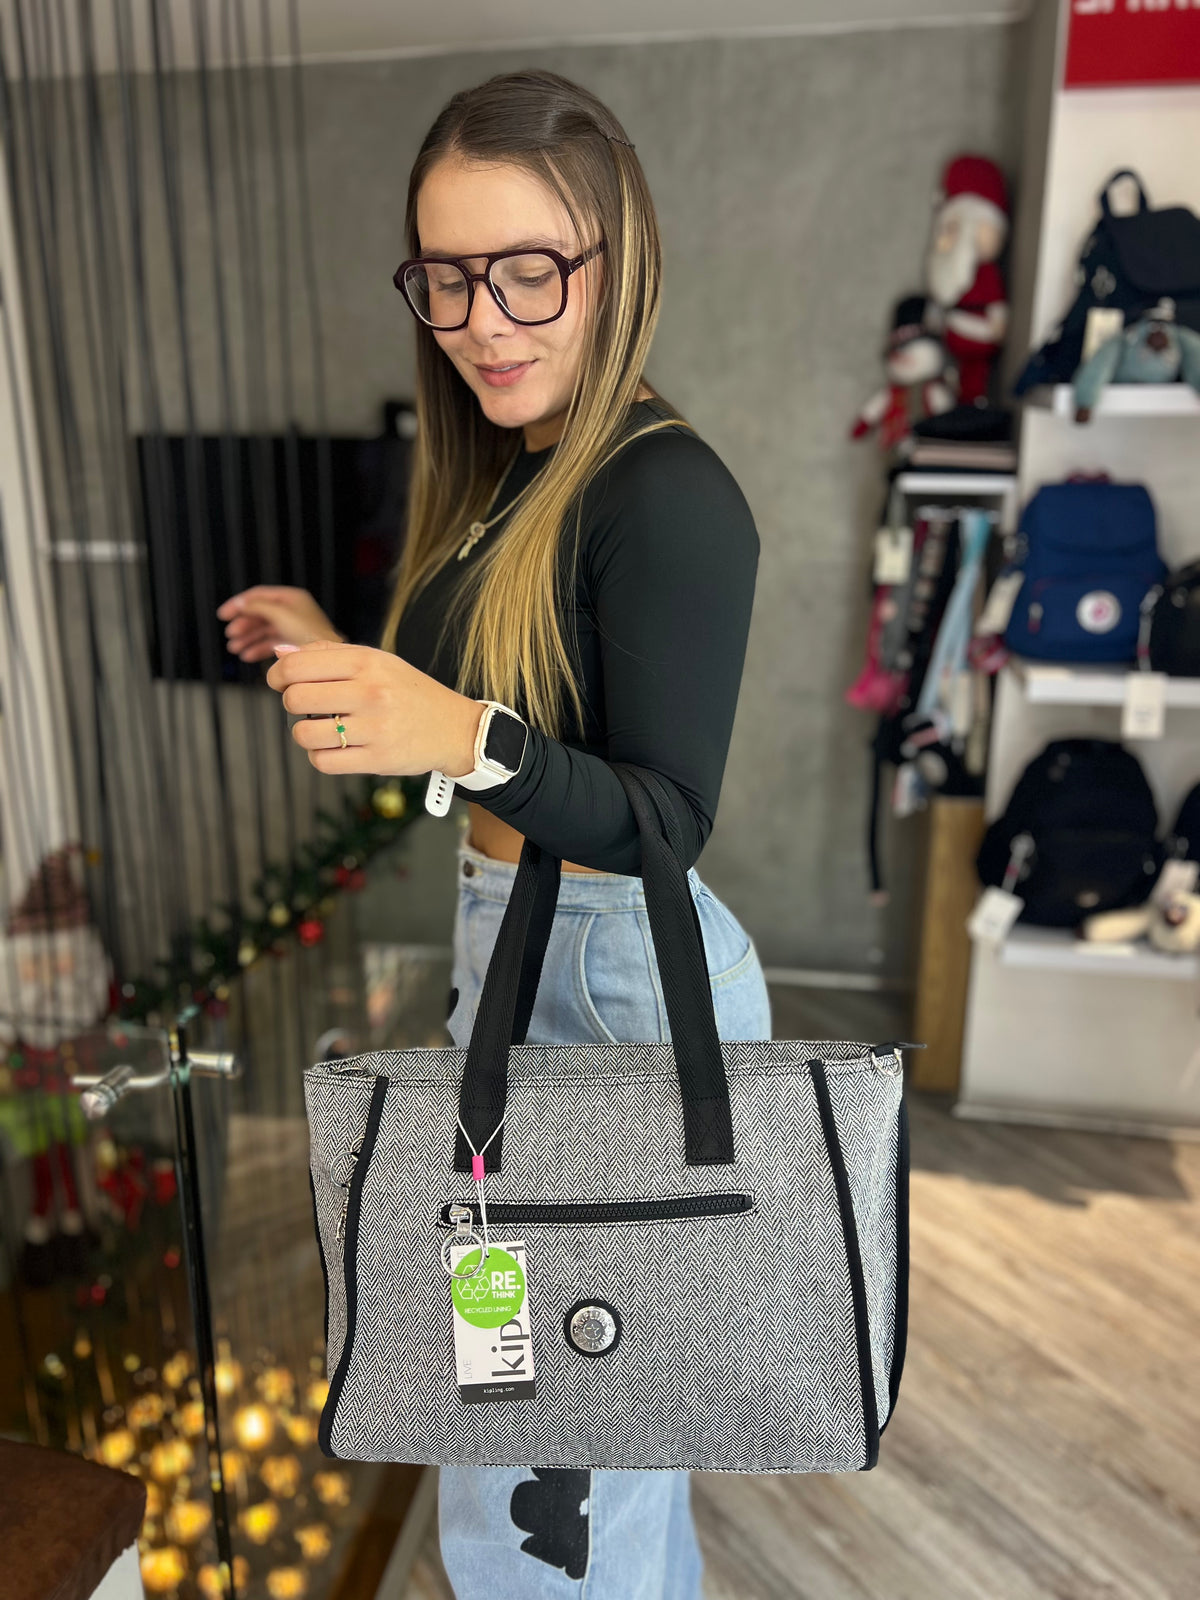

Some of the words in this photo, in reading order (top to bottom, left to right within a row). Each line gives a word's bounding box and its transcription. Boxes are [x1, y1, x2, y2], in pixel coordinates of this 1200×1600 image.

[491, 1271, 521, 1290] RE.
[492, 1291, 516, 1299] THINK
[493, 1305, 512, 1313] LINING
[463, 1360, 473, 1379] LIVE
